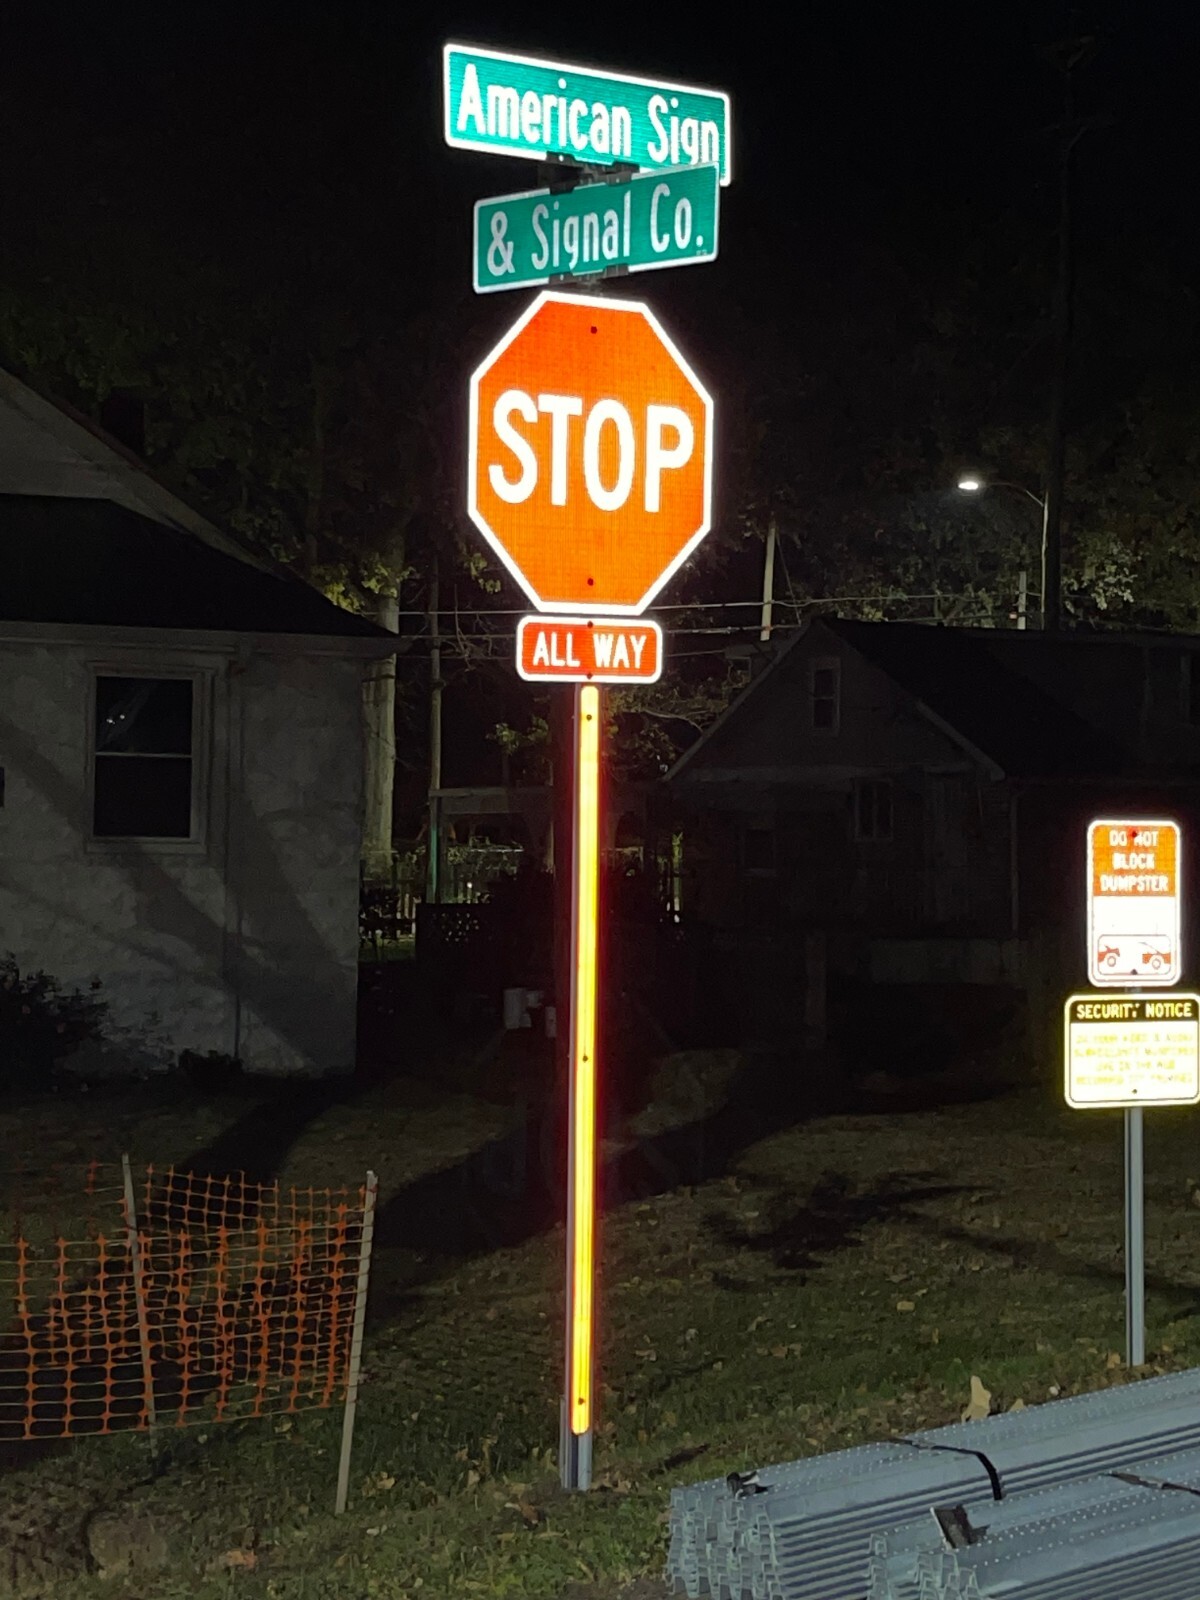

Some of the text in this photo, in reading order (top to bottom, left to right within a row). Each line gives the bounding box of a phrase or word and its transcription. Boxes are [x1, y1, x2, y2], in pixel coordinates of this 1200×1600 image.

[457, 63, 720, 164] American Sign
[487, 183, 704, 276] & Signal Co.
[488, 390, 694, 513] STOP
[533, 631, 647, 668] ALL WAY
[1109, 830, 1158, 847] DO NOT
[1112, 852, 1155, 870] BLOCK
[1100, 875, 1169, 892] DUMPSTER
[1076, 1002, 1193, 1019] SECURITY NOTICE
